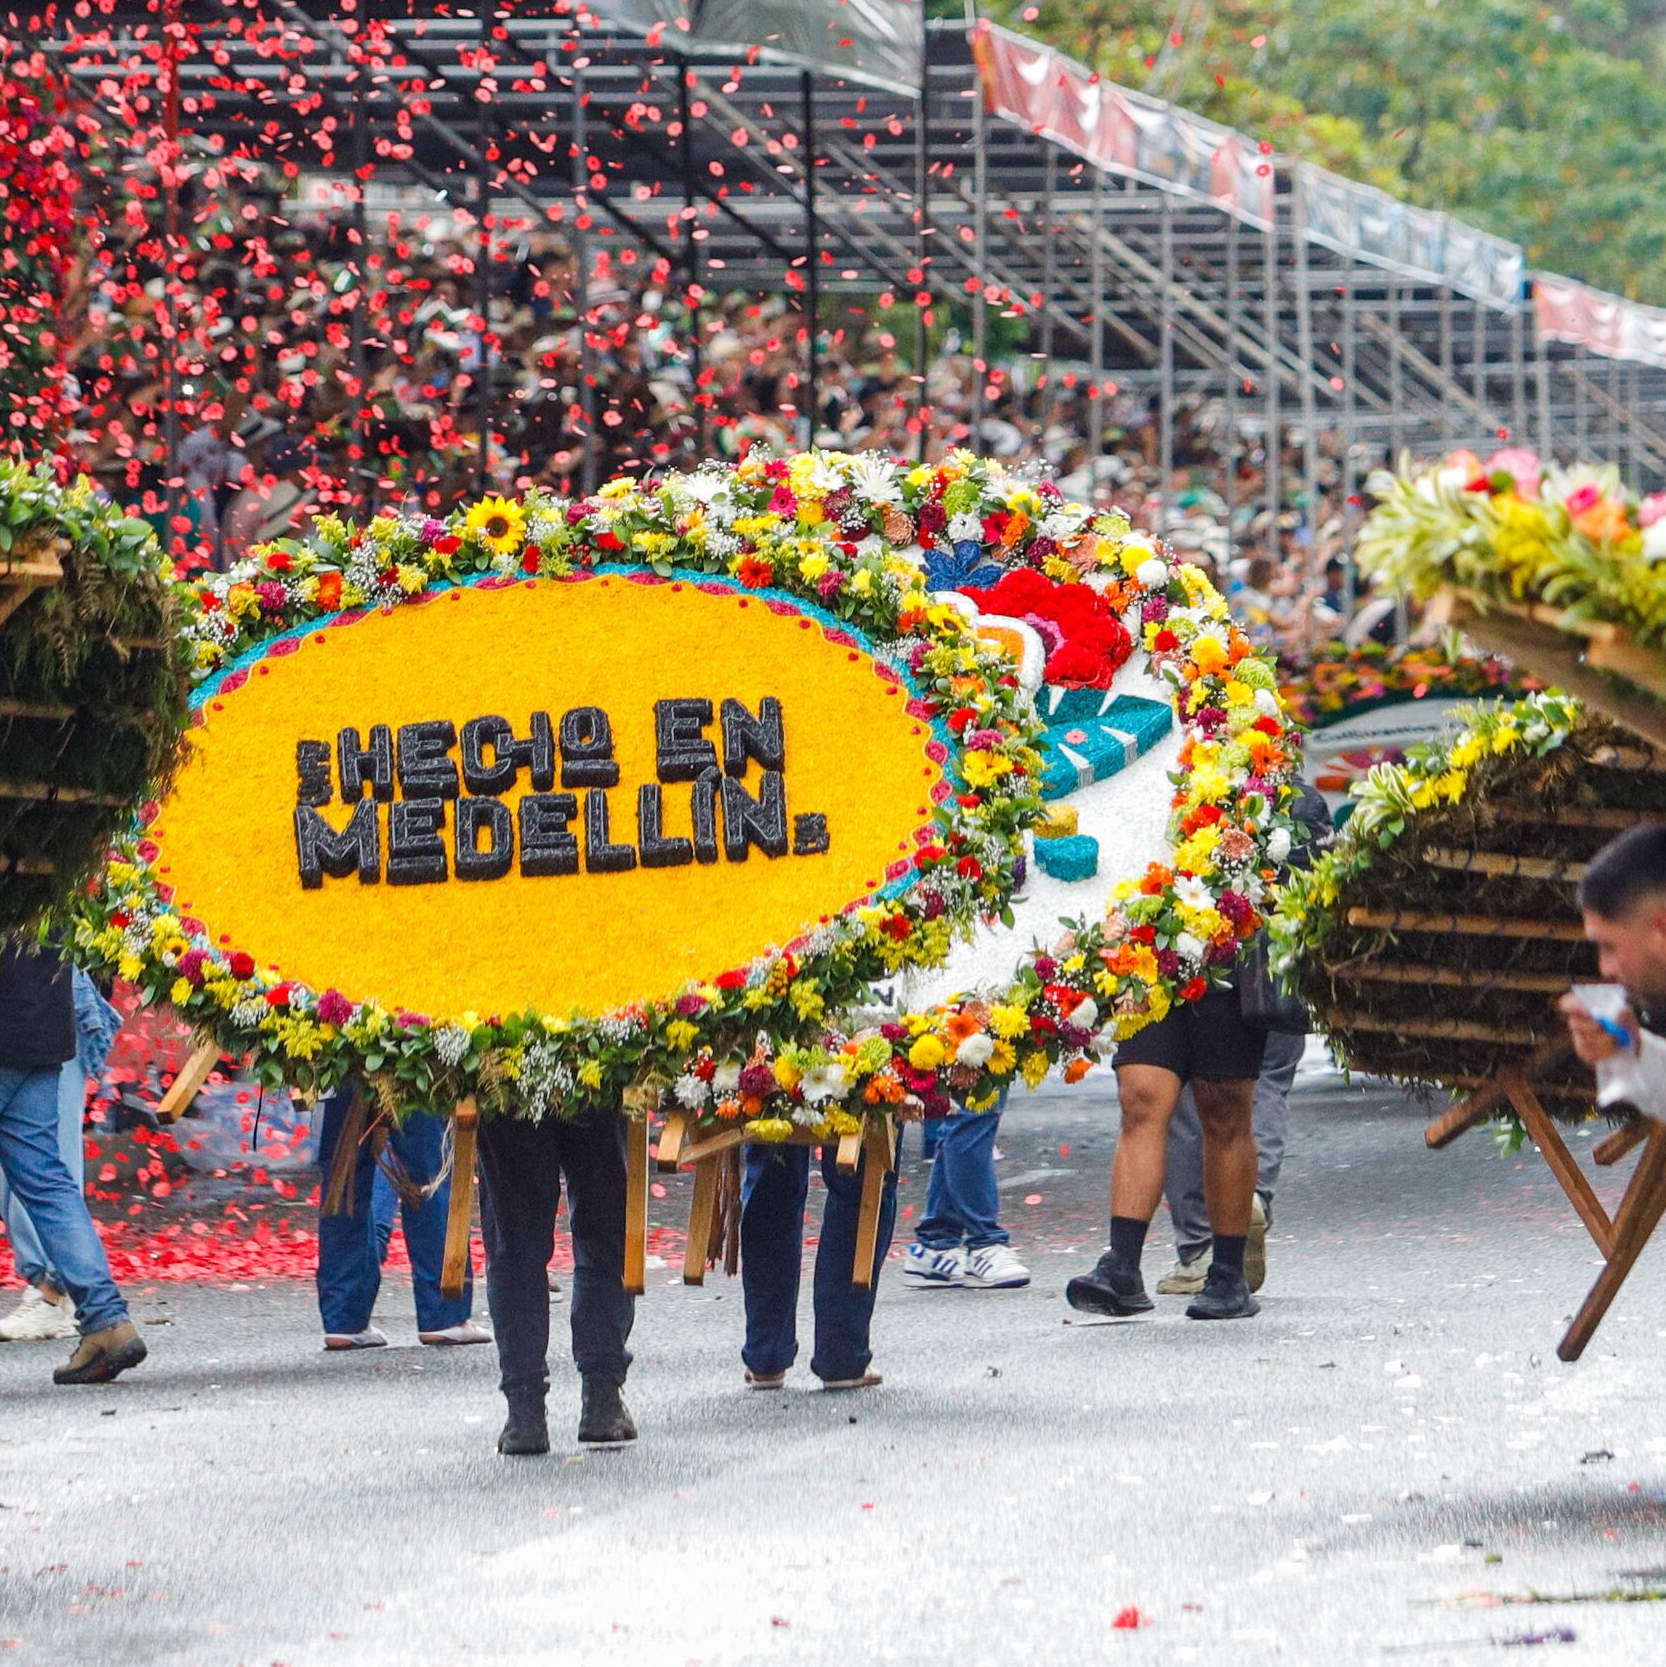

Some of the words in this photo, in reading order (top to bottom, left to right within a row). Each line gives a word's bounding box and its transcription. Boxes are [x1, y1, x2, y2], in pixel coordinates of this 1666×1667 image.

[336, 705, 621, 804] HECHO
[653, 695, 786, 784] EN
[293, 766, 789, 890] MEDELLÍN
